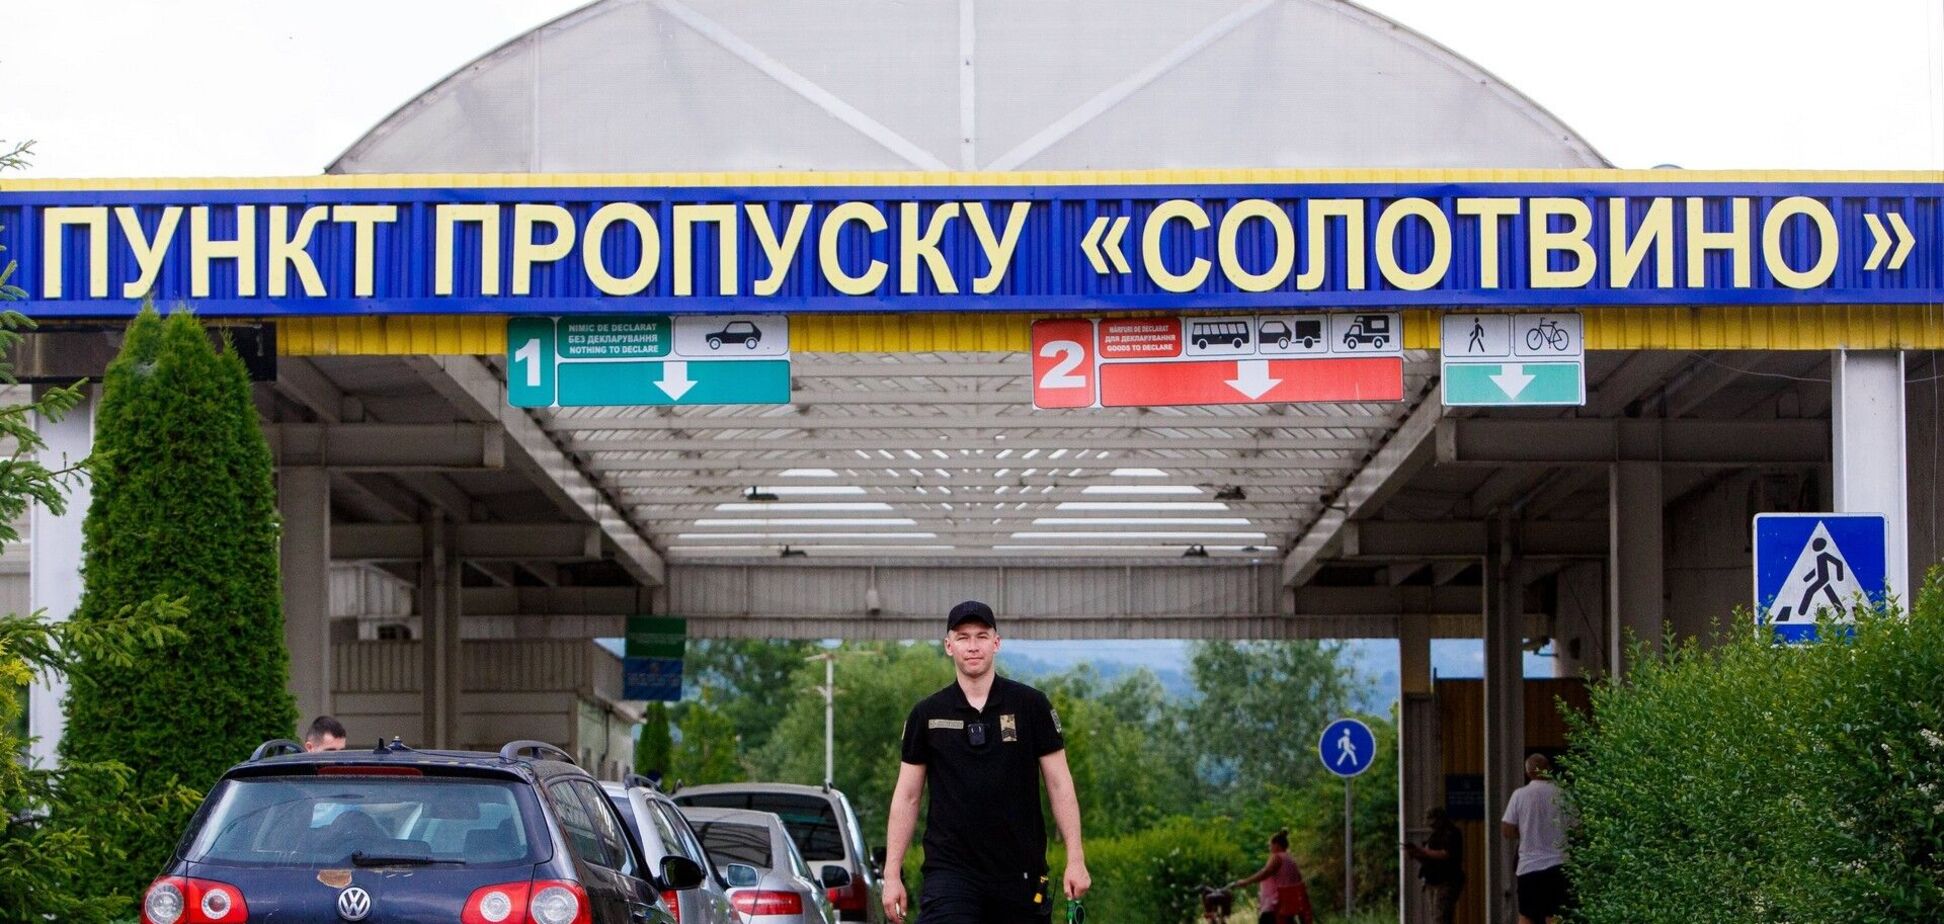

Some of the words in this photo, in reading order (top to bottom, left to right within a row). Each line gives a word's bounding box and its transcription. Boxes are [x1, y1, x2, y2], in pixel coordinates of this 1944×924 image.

[43, 204, 397, 298] ПУНКТ
[434, 201, 1031, 296] ПРОПУСКУ
[568, 323, 595, 332] NIMIC
[597, 323, 609, 332] DE
[611, 323, 657, 332] DECLARAT
[1142, 325, 1169, 333] DECLARAT
[568, 335, 586, 344] БЕЗ
[587, 334, 658, 345] ДЕКЛАРУВАННЯ
[1105, 335, 1120, 343] ДЛЯ
[1121, 334, 1176, 343] ДЕКЛАРУВАННЯ
[569, 346, 607, 354] NOTHING
[609, 345, 620, 354] TO
[622, 345, 659, 353] DECLARE
[1107, 344, 1131, 352] GOODS
[515, 338, 541, 387] 1
[1039, 340, 1086, 389] 2
